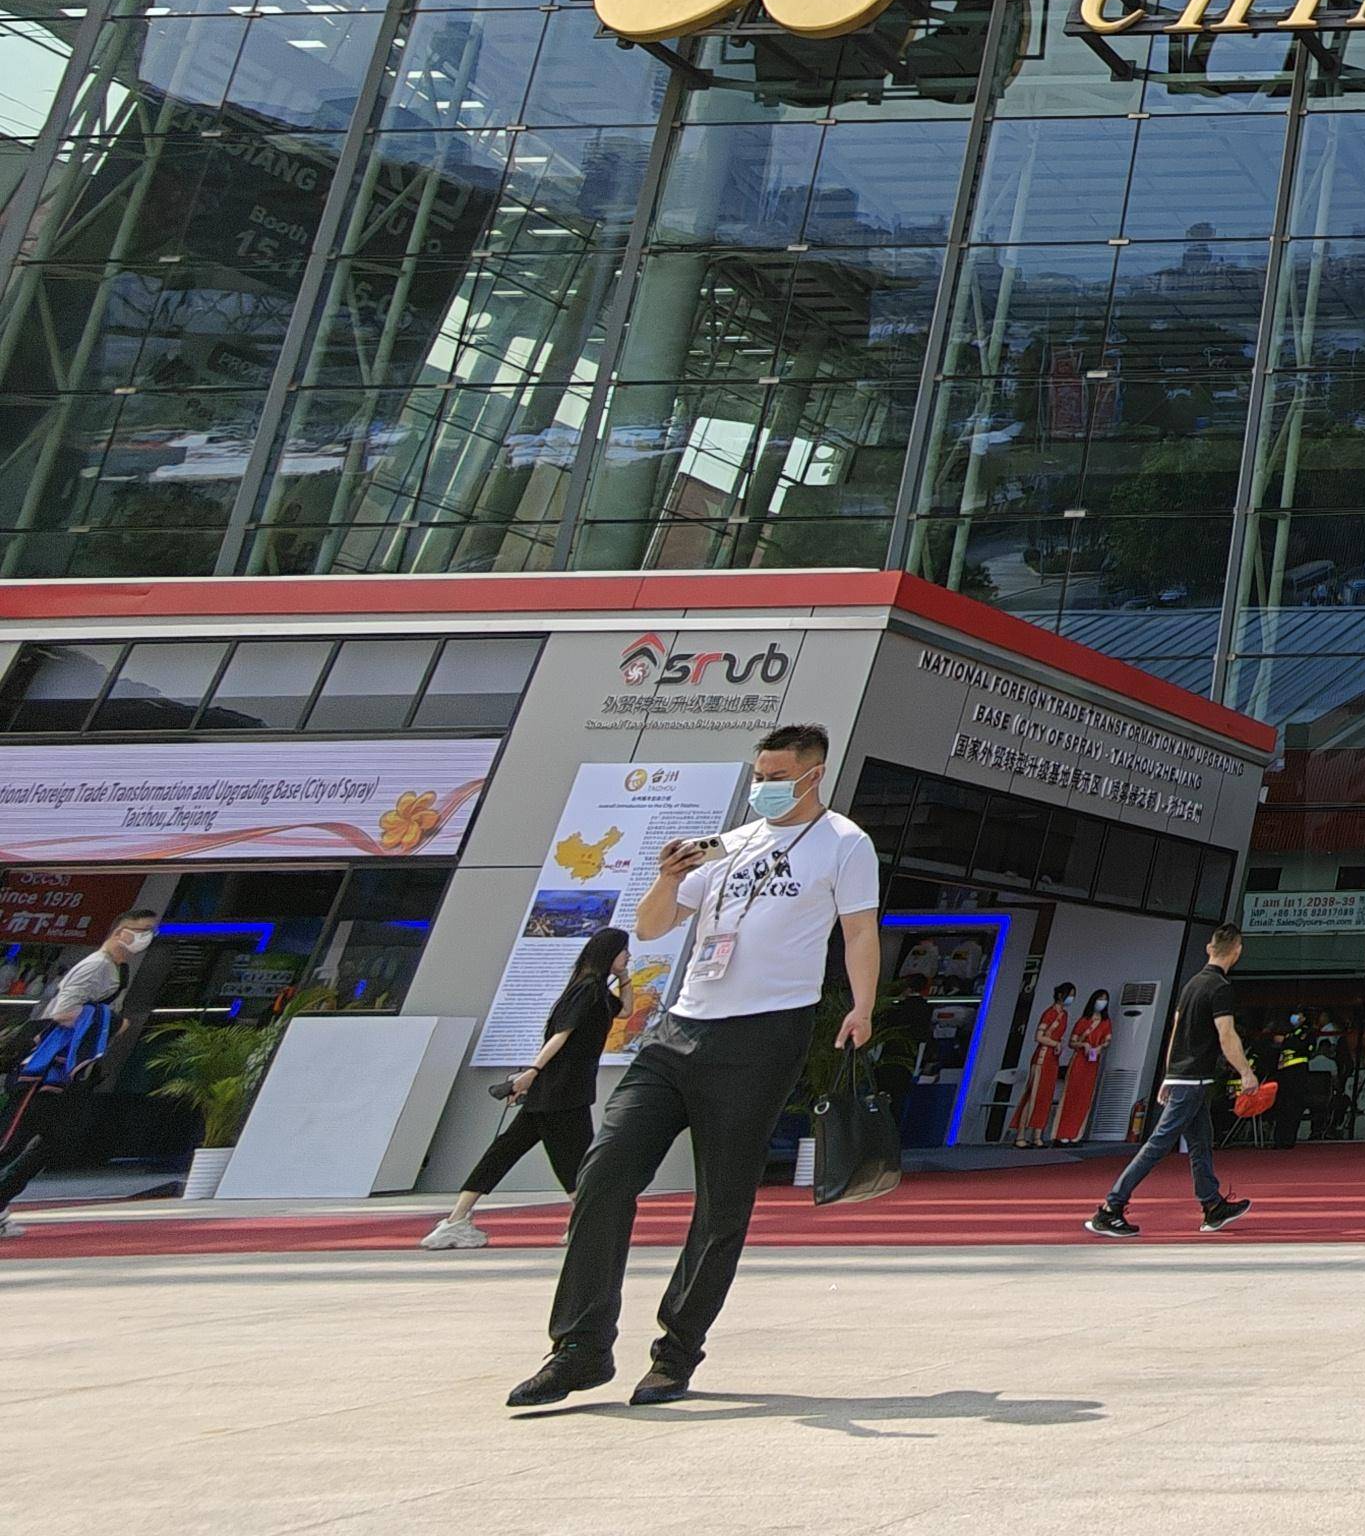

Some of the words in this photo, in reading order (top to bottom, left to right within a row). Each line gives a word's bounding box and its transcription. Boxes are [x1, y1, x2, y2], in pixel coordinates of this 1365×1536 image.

[250, 204, 308, 244] Booth
[918, 649, 990, 690] NATIONAL
[989, 675, 1048, 710] FOREIGN
[1047, 695, 1087, 724] TRADE
[1085, 708, 1177, 754] TRANSFORMATION
[1175, 740, 1196, 761] AND
[1194, 745, 1245, 777] UPGRADING
[972, 703, 1012, 731] BASE
[1012, 714, 1047, 742] (CITY
[1046, 728, 1066, 749] OF
[1063, 732, 1104, 761] SPRAY)
[33, 782, 75, 809] Foreign
[73, 781, 107, 803] Trade
[106, 780, 194, 802] Transformation
[192, 779, 217, 801] and
[215, 778, 275, 806] Upgrading
[272, 779, 302, 800] Base
[300, 776, 328, 805] (City
[327, 777, 342, 800] of
[340, 775, 381, 805] Spray)
[651, 768, 680, 783] 台州
[0, 886, 38, 905] ince
[42, 890, 84, 907] 1978
[1262, 898, 1280, 908] am
